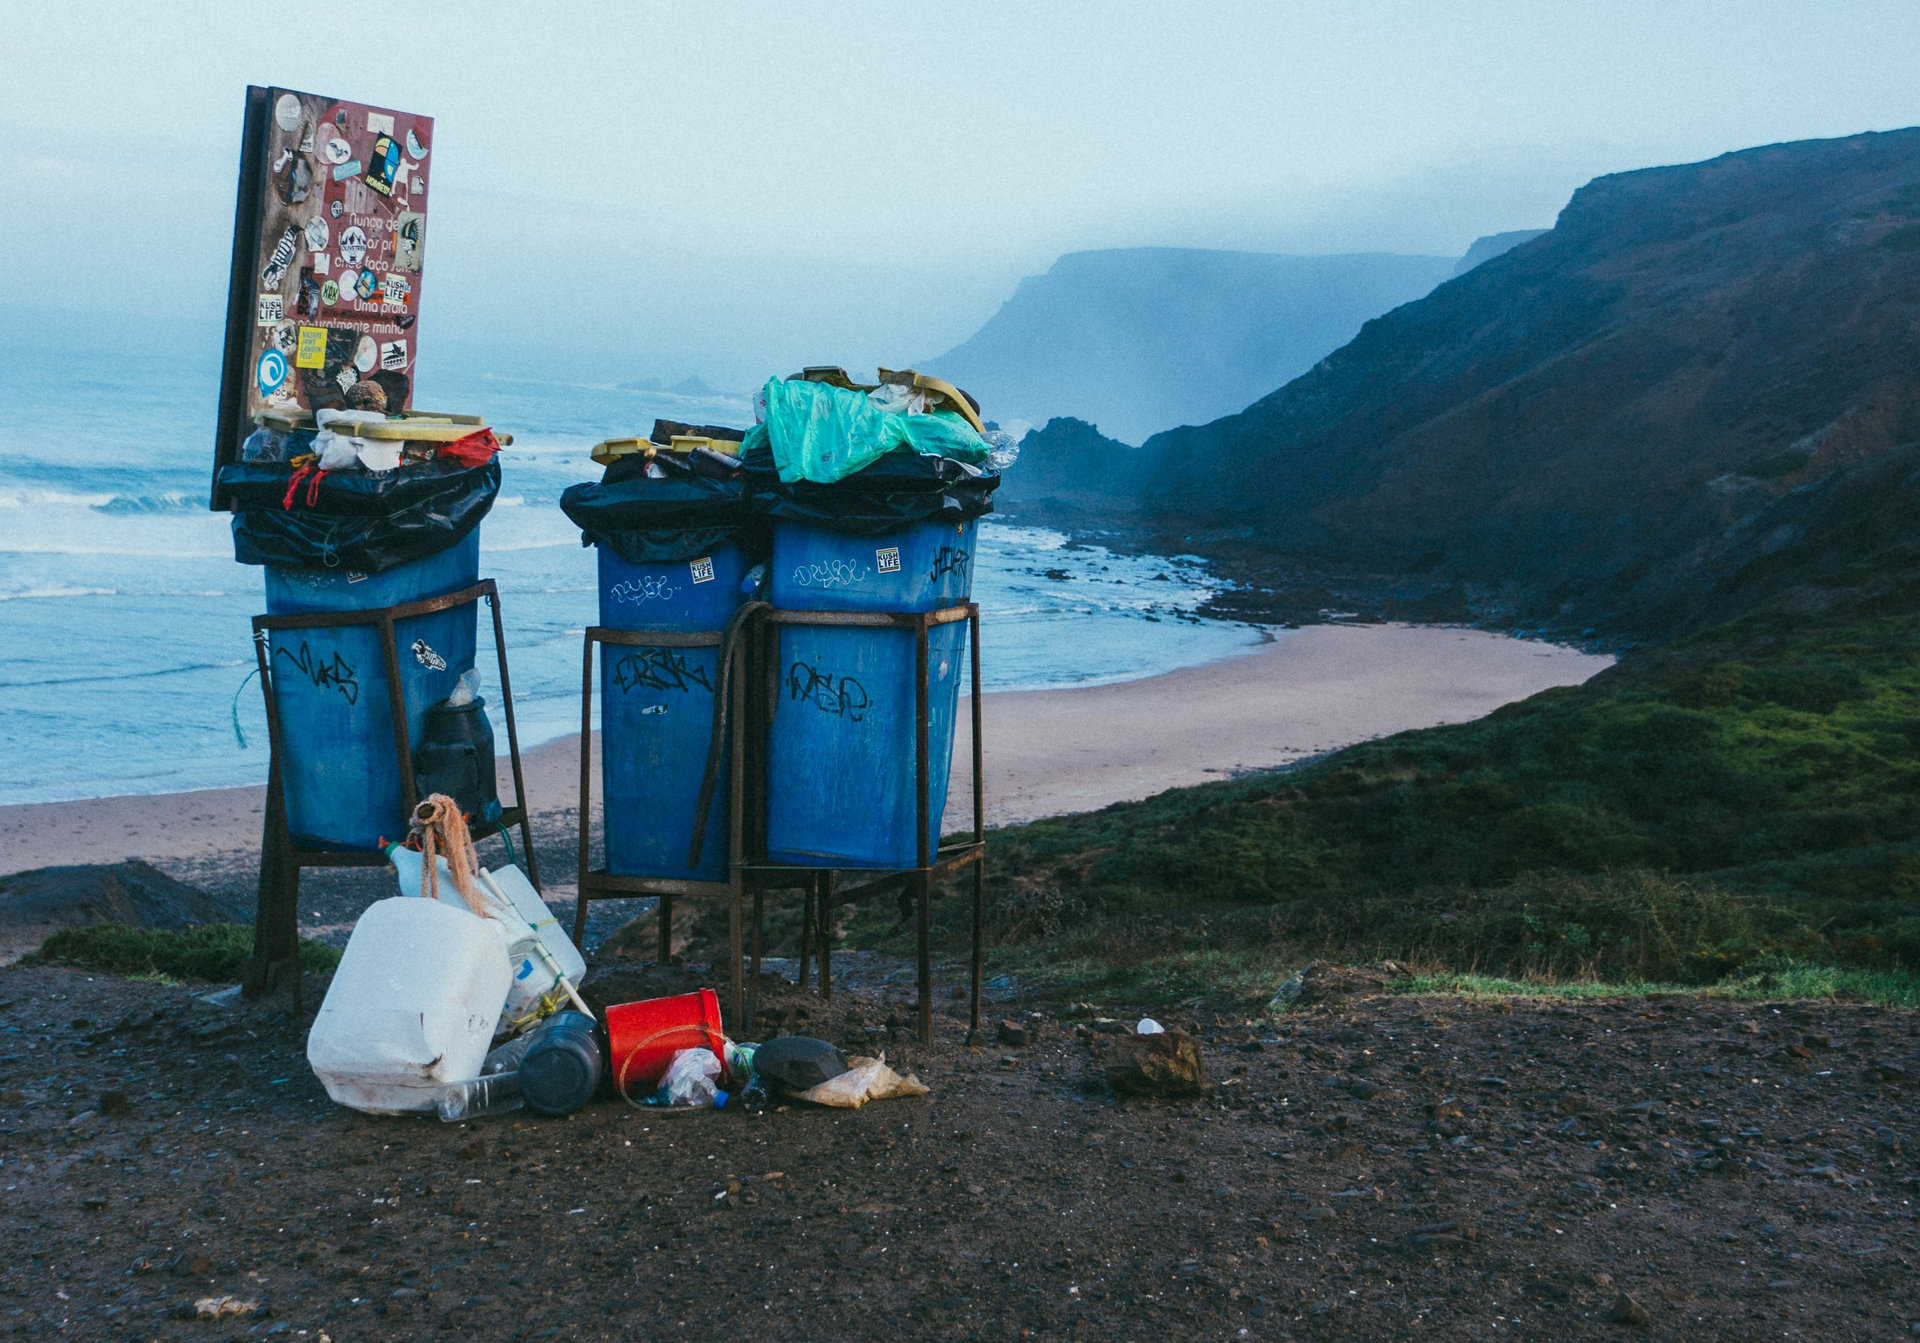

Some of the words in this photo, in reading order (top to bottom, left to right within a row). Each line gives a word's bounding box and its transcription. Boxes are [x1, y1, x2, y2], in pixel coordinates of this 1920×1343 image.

[349, 212, 383, 229] Nunca
[386, 279, 405, 291] KUSH
[384, 288, 404, 299] LIFE
[259, 301, 282, 310] KUSH
[354, 299, 378, 313] Uma
[381, 302, 408, 318] praia
[259, 309, 282, 320] LIFE
[877, 551, 898, 561] KUSH
[692, 561, 711, 572] KUSH
[878, 559, 899, 568] LIFE
[693, 568, 713, 579] LIFE
